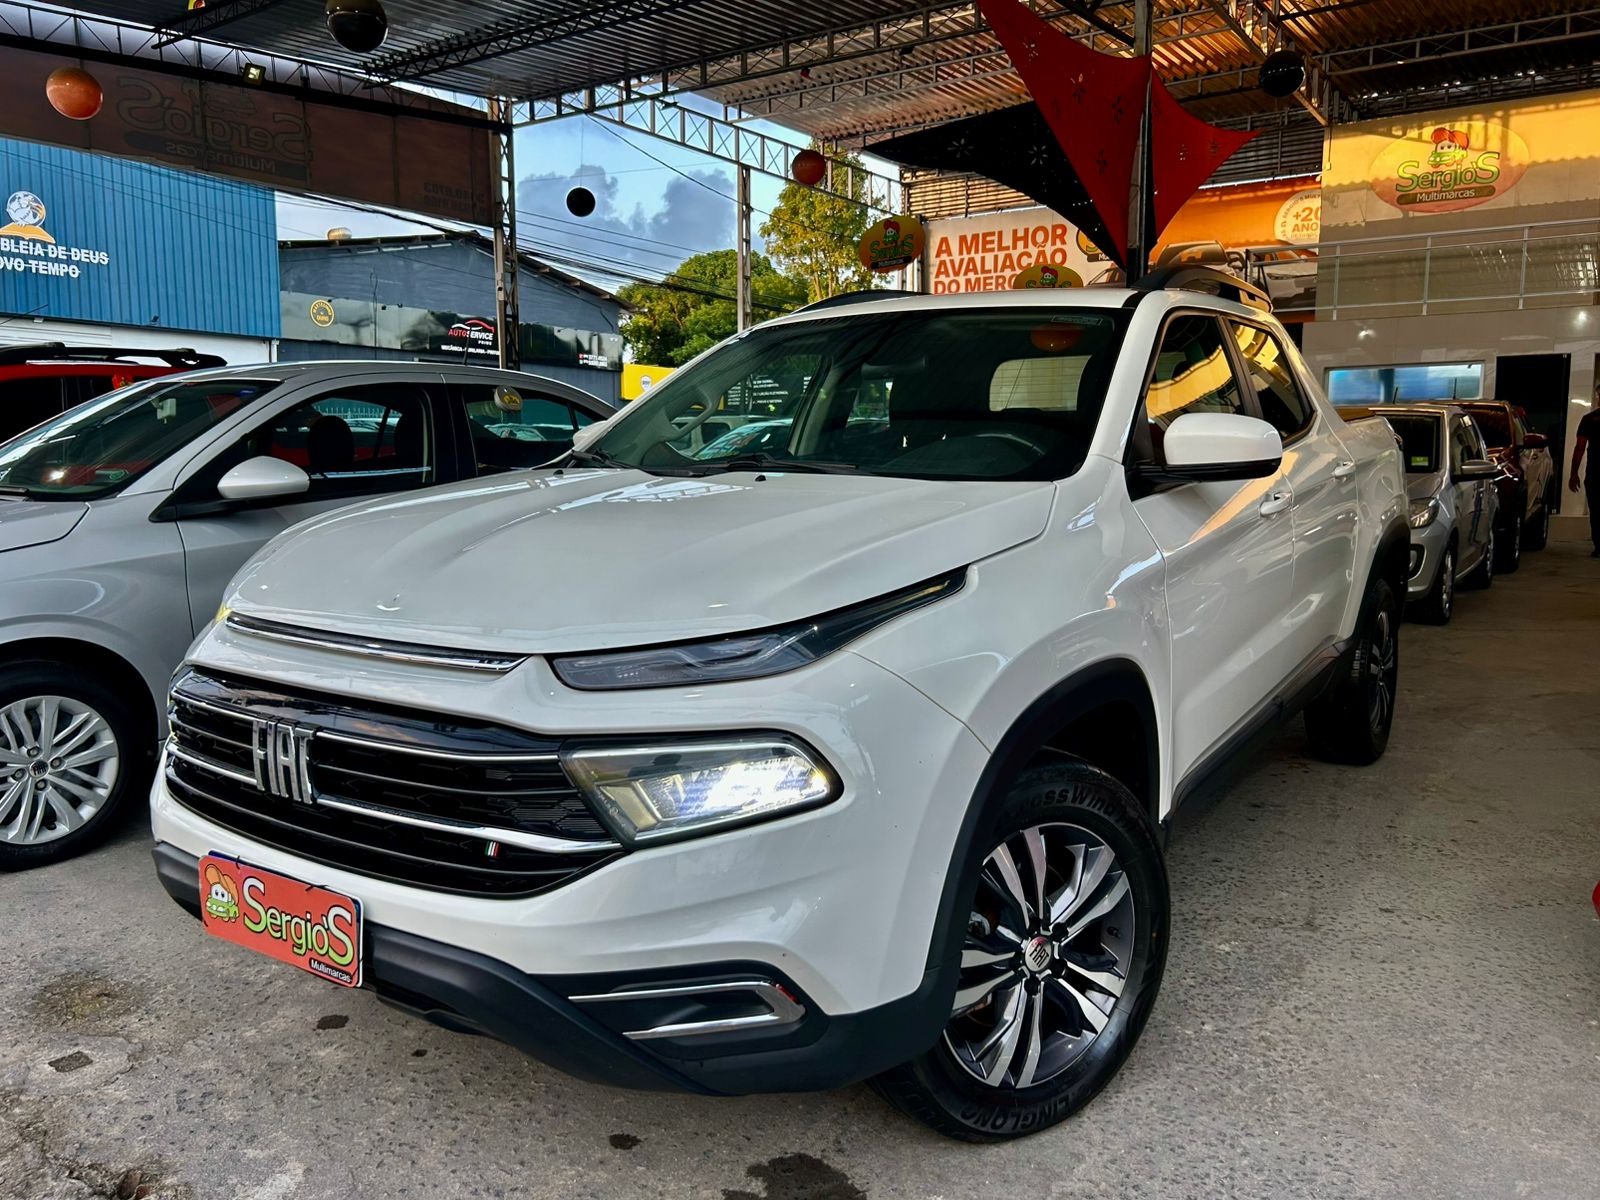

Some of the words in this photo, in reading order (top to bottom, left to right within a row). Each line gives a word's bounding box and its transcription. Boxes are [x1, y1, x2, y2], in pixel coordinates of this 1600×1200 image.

[1396, 151, 1500, 192] Sergio'S
[1416, 188, 1476, 203] Multimarcas
[935, 236, 954, 259] A
[958, 223, 1068, 256] MELHOR
[47, 244, 68, 260] DE
[70, 247, 109, 265] DEUS
[28, 260, 80, 278] TEMPO
[934, 278, 960, 295] DO
[252, 719, 316, 805] FIAT
[242, 875, 355, 967] Sergio'S
[1028, 942, 1050, 969] FIAT
[310, 958, 353, 984] Multimarcas
